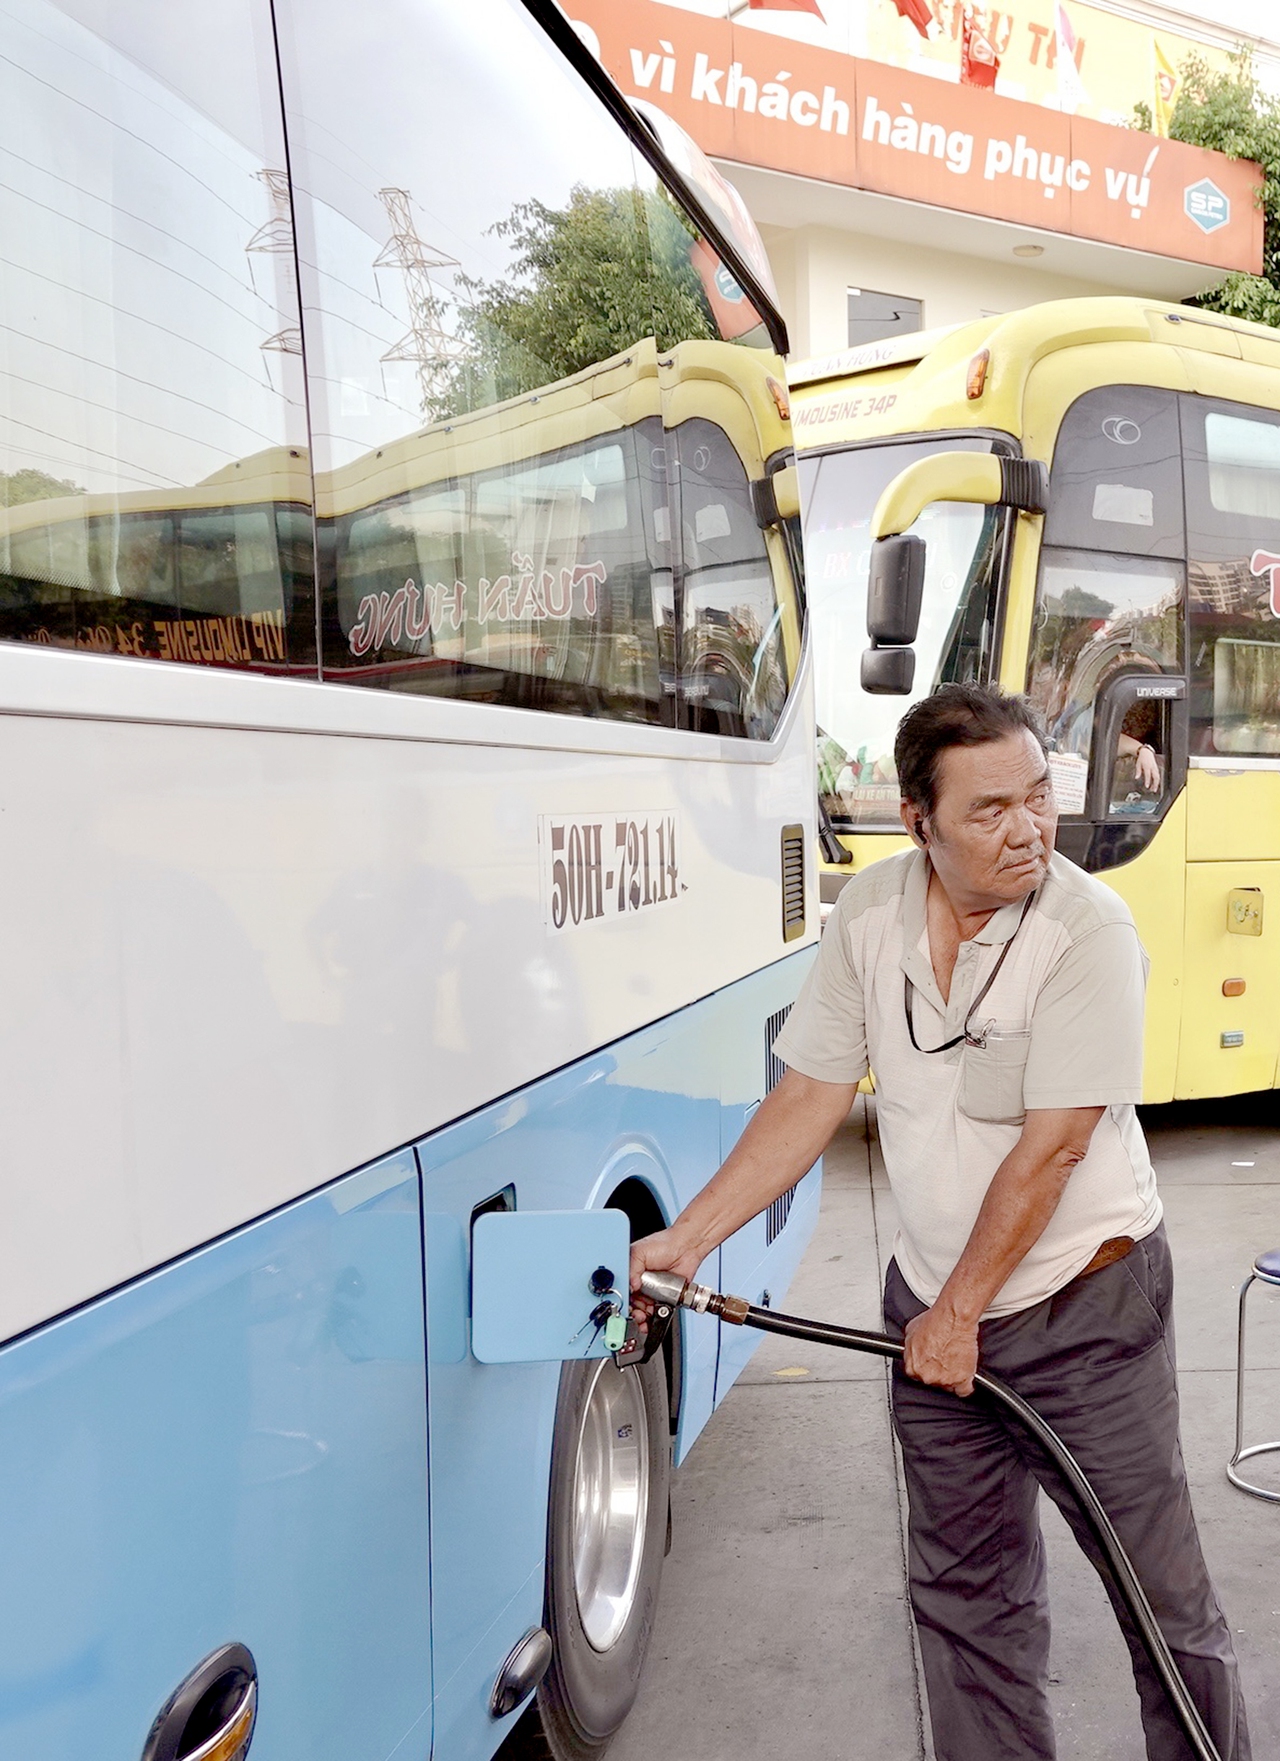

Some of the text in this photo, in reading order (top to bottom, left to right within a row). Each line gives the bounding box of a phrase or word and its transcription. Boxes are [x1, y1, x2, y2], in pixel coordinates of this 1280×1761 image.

[629, 39, 676, 94] vì
[690, 52, 851, 136] khách
[861, 96, 974, 175] hàng
[984, 135, 1092, 200] phục
[1190, 190, 1224, 213] SP
[791, 394, 898, 428] IMOUSINE 34P
[1136, 686, 1178, 697] UNIVERSE
[551, 816, 679, 930] 50H-721.14
